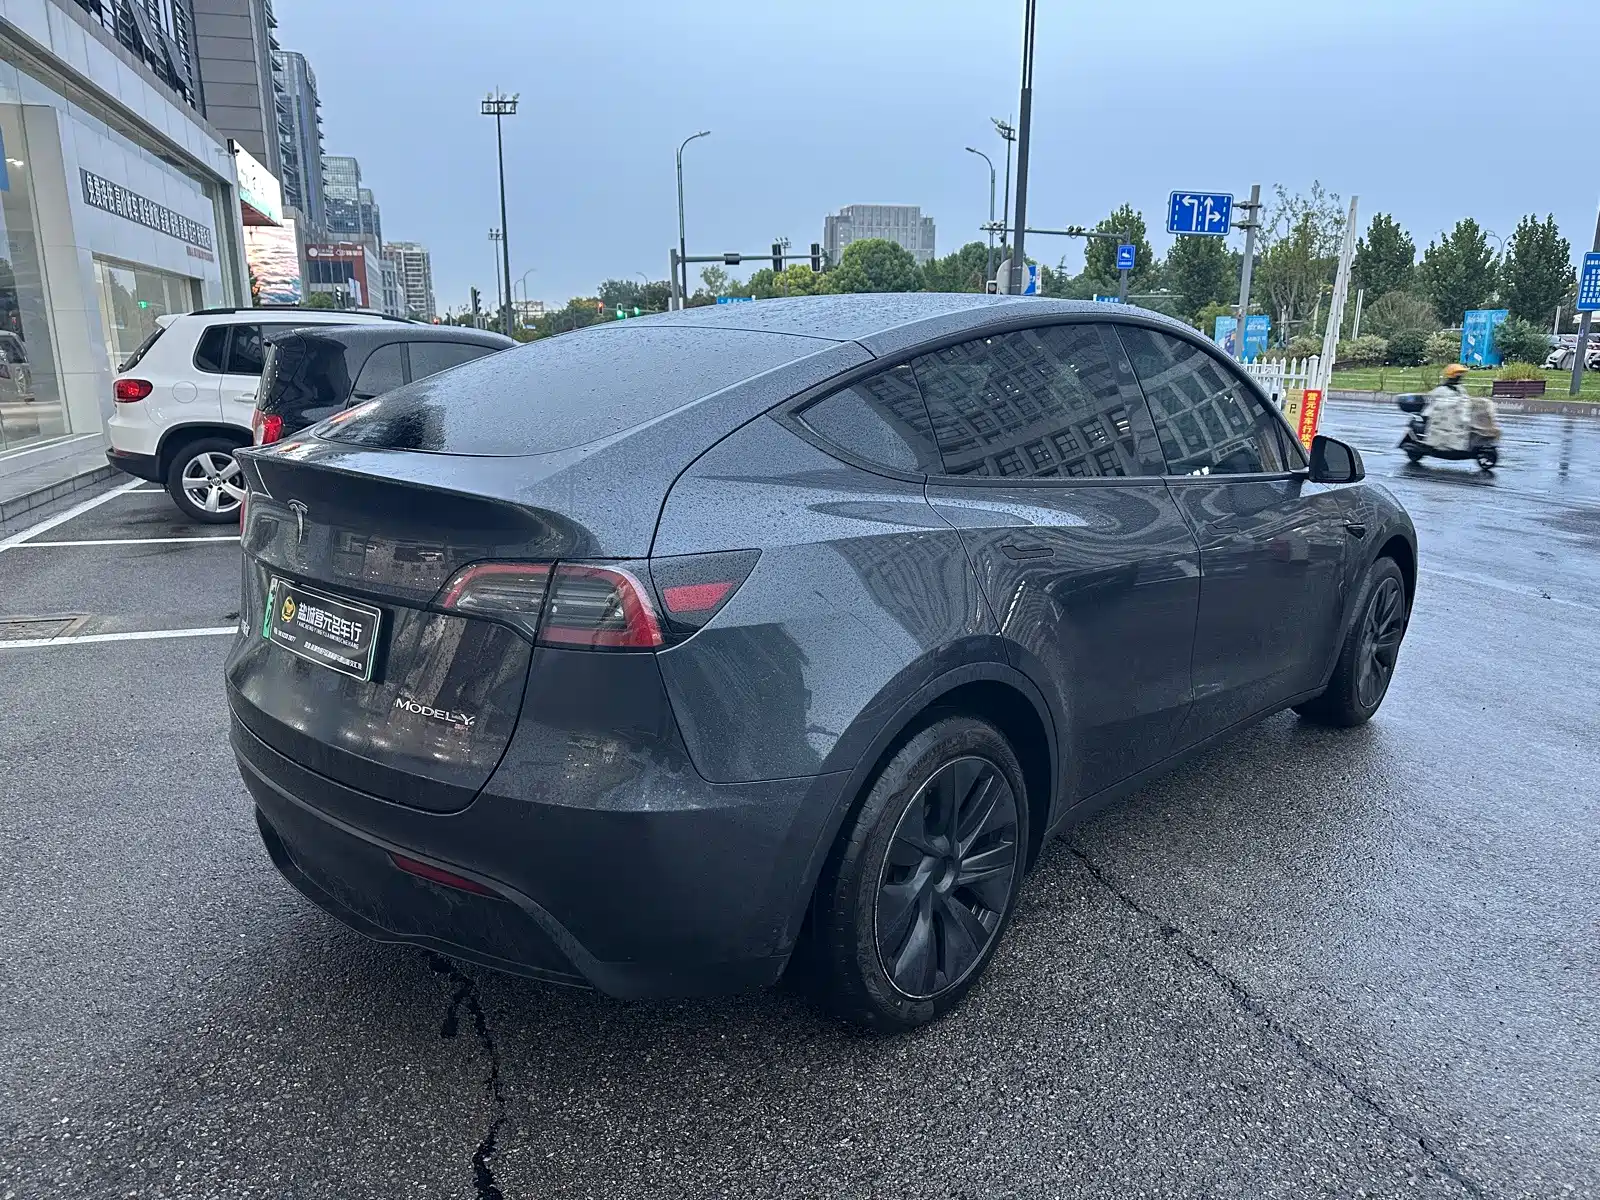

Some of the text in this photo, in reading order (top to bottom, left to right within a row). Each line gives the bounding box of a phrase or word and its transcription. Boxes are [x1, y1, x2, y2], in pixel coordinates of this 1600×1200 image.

[297, 602, 363, 642] 盐城营元名车行
[395, 698, 475, 726] MODEL Y
